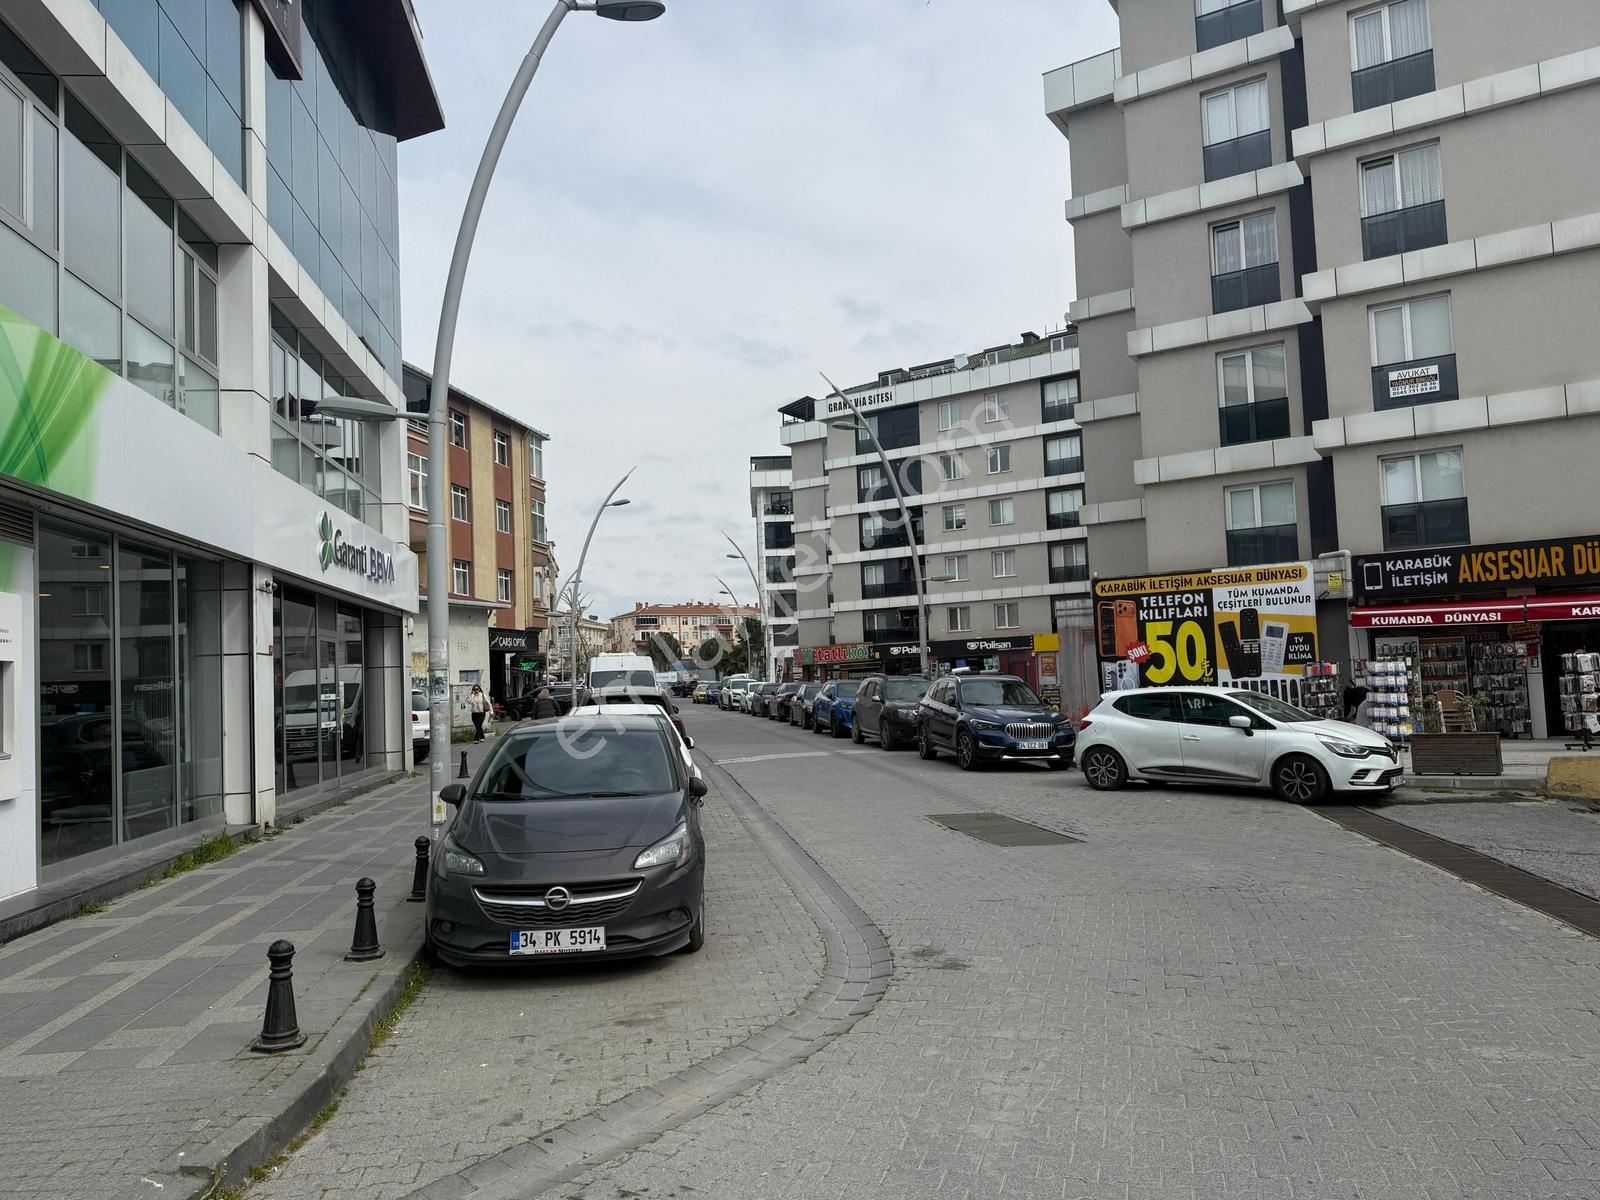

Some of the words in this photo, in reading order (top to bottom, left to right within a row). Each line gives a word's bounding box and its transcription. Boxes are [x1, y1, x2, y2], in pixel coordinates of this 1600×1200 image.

[1396, 368, 1430, 379] AVUKAT
[334, 528, 367, 574] Garanti
[369, 546, 395, 582] BBVA
[1458, 547, 1566, 583] AKSESUAR
[1573, 541, 1600, 575] DÜ
[1385, 554, 1452, 571] KARABÜK
[1100, 579, 1147, 594] KARABÜK
[1149, 574, 1193, 591] İLETİŞİM
[1196, 573, 1252, 587] AKSESUAR
[1256, 568, 1302, 581] DÜNYASI
[1391, 572, 1448, 587] İLETİŞİM
[1227, 588, 1250, 598] TÜM
[1251, 585, 1300, 597] KUMANDA
[1141, 593, 1204, 607] TELEFON
[1217, 595, 1262, 611] ÇEŞİTLERİ
[1266, 595, 1312, 606] BULUNUR
[1139, 605, 1208, 621] KILIFLARI
[1571, 606, 1600, 616] KAR
[1371, 615, 1433, 625] KUMANDA
[1444, 612, 1502, 623] DÜNYASI
[979, 640, 1012, 650] Polisan
[1293, 636, 1304, 644] TV
[902, 645, 931, 654] Polisn
[1127, 646, 1148, 662] ŞOK!
[1145, 620, 1207, 684] 50
[1289, 644, 1310, 652] UYDU
[1288, 651, 1313, 660] KLİMA
[520, 933, 537, 948] 34
[545, 931, 561, 947] PK
[569, 929, 601, 946] 5914
